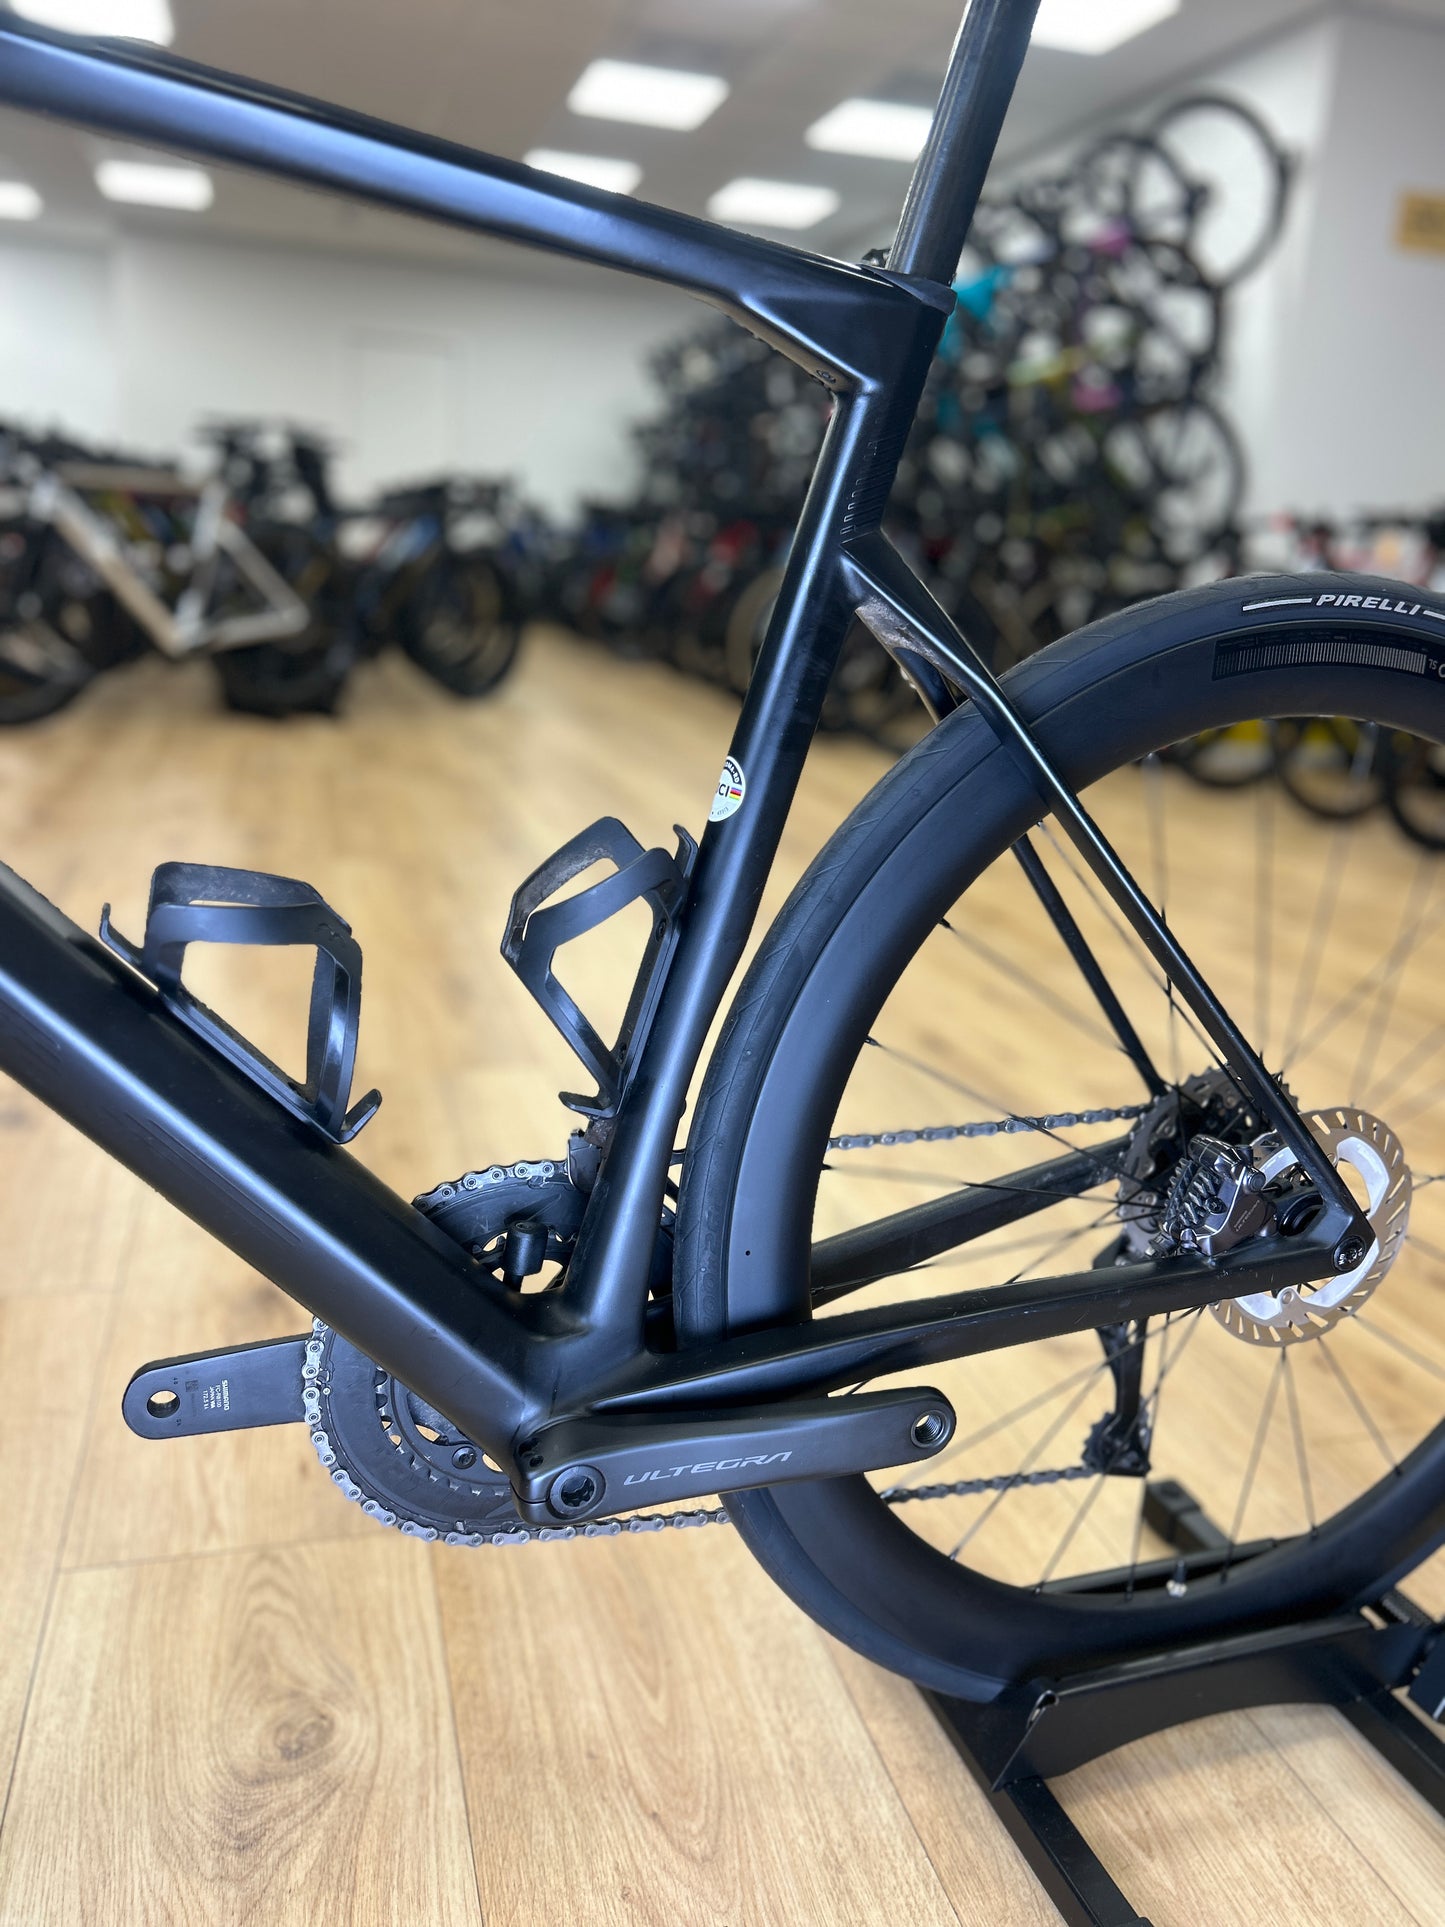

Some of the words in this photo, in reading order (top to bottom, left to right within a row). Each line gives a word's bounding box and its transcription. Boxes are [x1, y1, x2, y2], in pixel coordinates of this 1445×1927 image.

[1316, 594, 1422, 616] PIRELLI
[718, 783, 731, 798] CI
[623, 1451, 793, 1486] ULTEGRA
